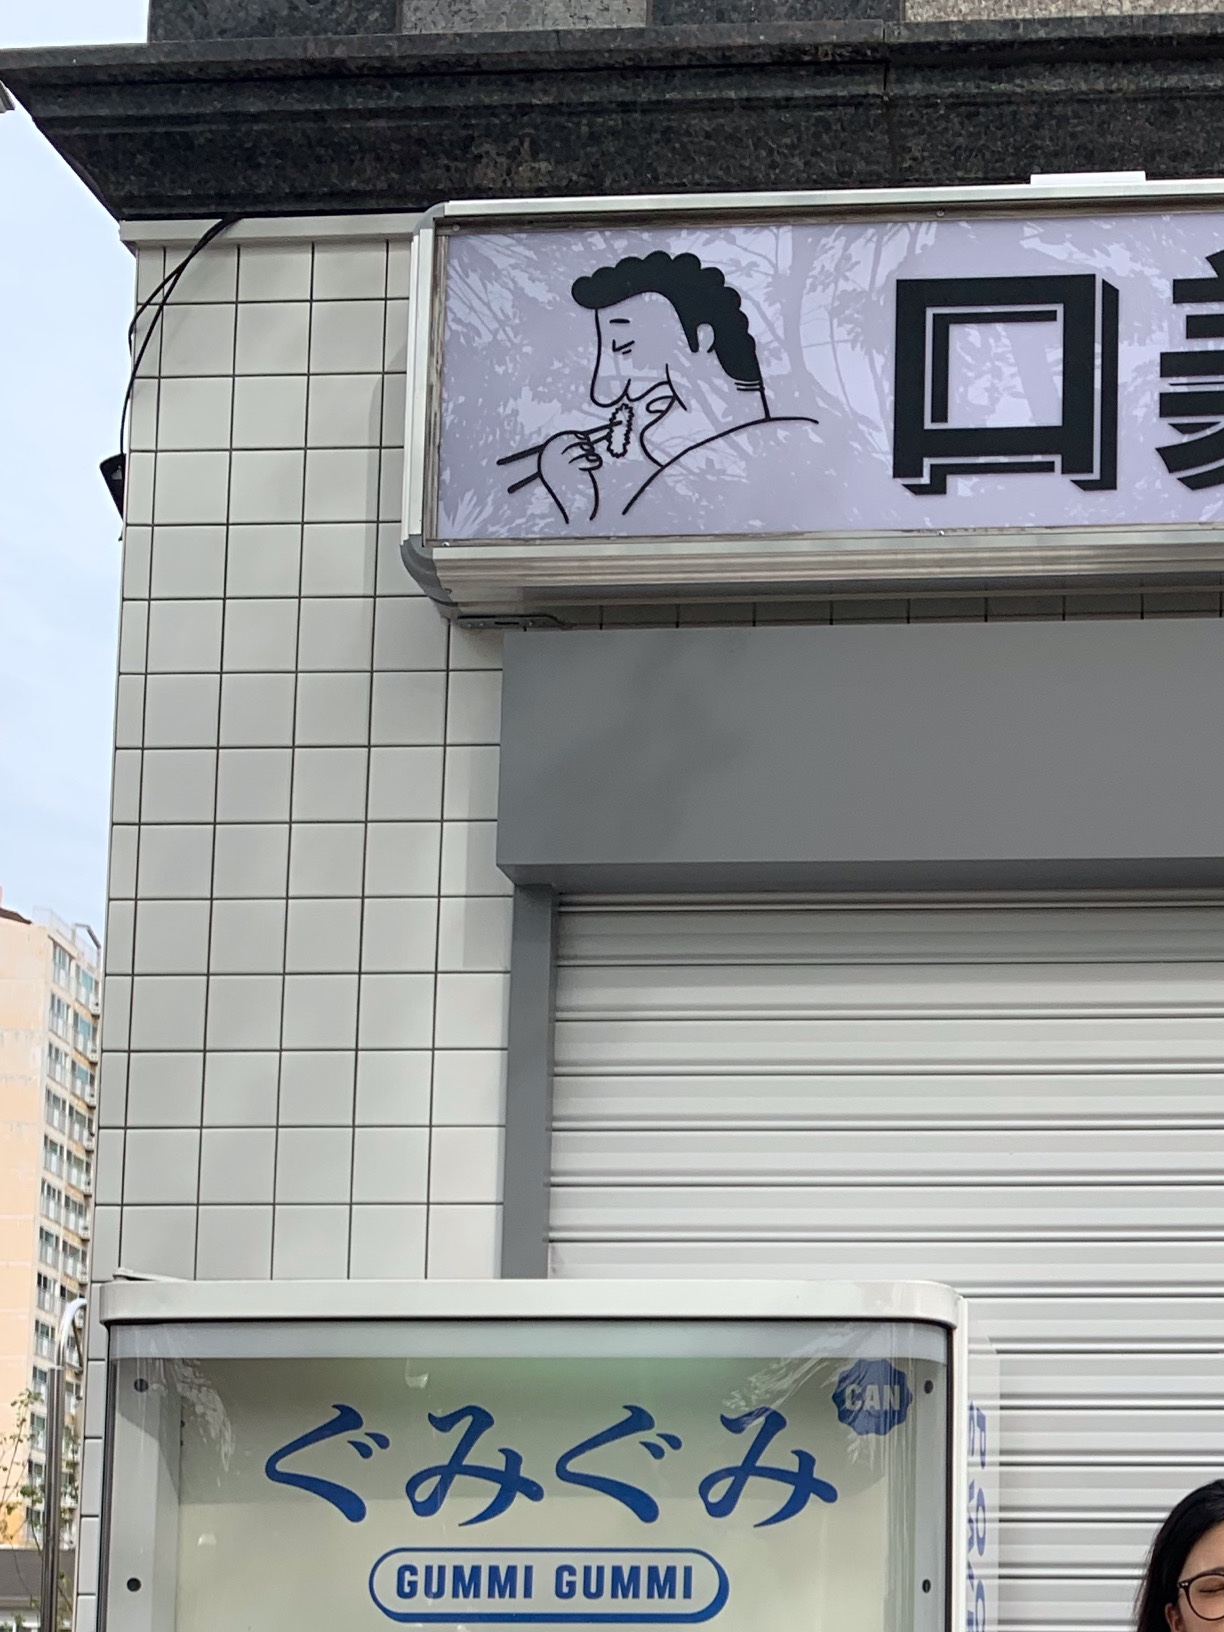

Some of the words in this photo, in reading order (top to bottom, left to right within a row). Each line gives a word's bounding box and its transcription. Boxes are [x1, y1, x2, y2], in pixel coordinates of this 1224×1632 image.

[845, 1383, 901, 1411] CAN
[265, 1403, 839, 1529] ぐみぐみ
[395, 1564, 535, 1601] GUMMI
[554, 1564, 694, 1601] GUMMI
